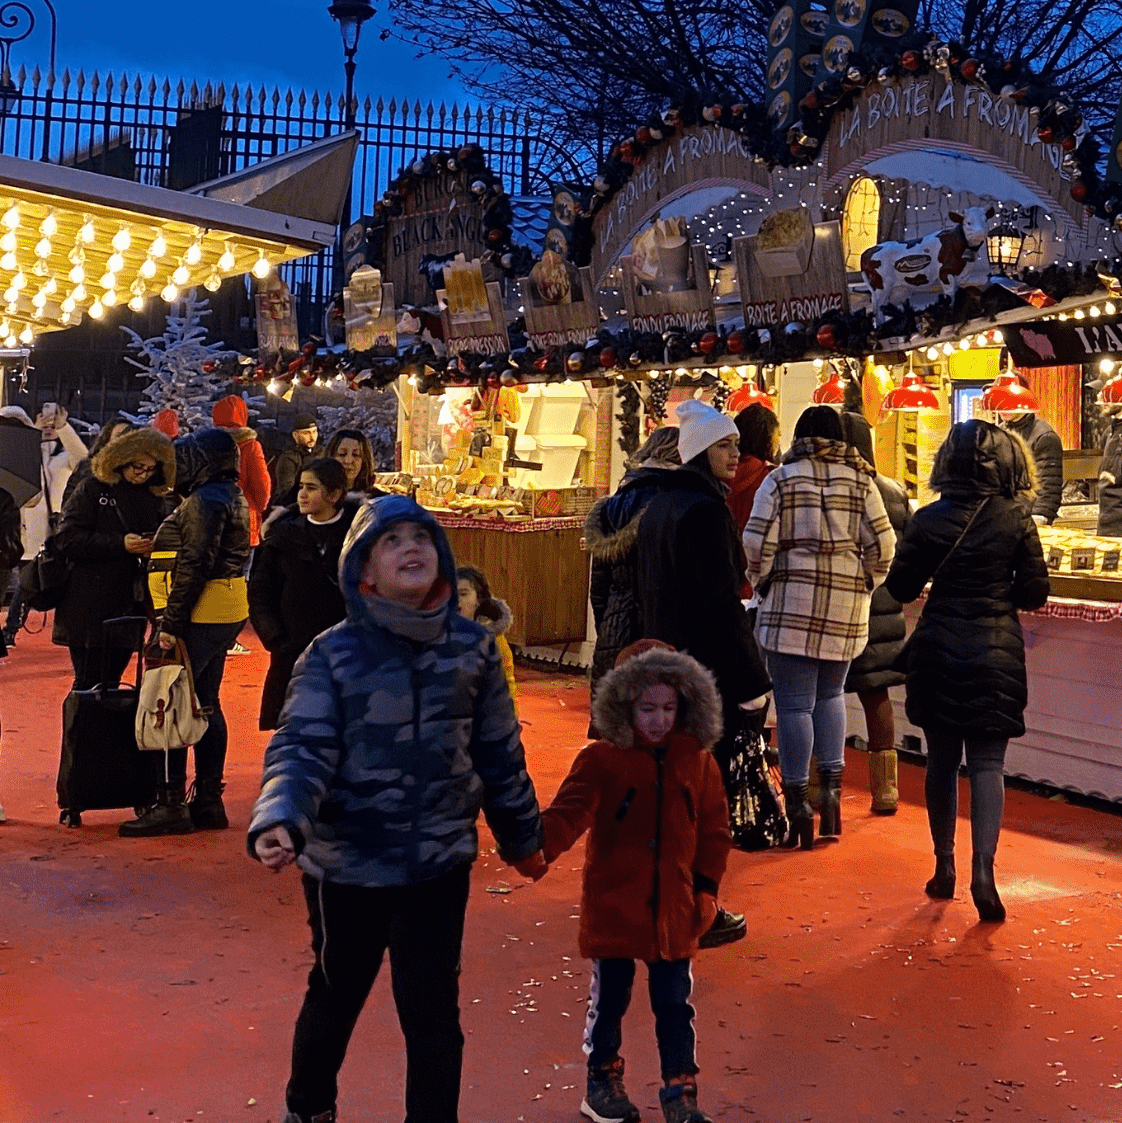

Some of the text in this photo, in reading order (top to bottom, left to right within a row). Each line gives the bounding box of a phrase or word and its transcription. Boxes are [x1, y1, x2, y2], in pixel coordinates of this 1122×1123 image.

[840, 104, 861, 148] LA
[868, 80, 930, 130] BOITE
[936, 82, 955, 119] A
[663, 144, 676, 175] A
[746, 301, 778, 325] BOITE
